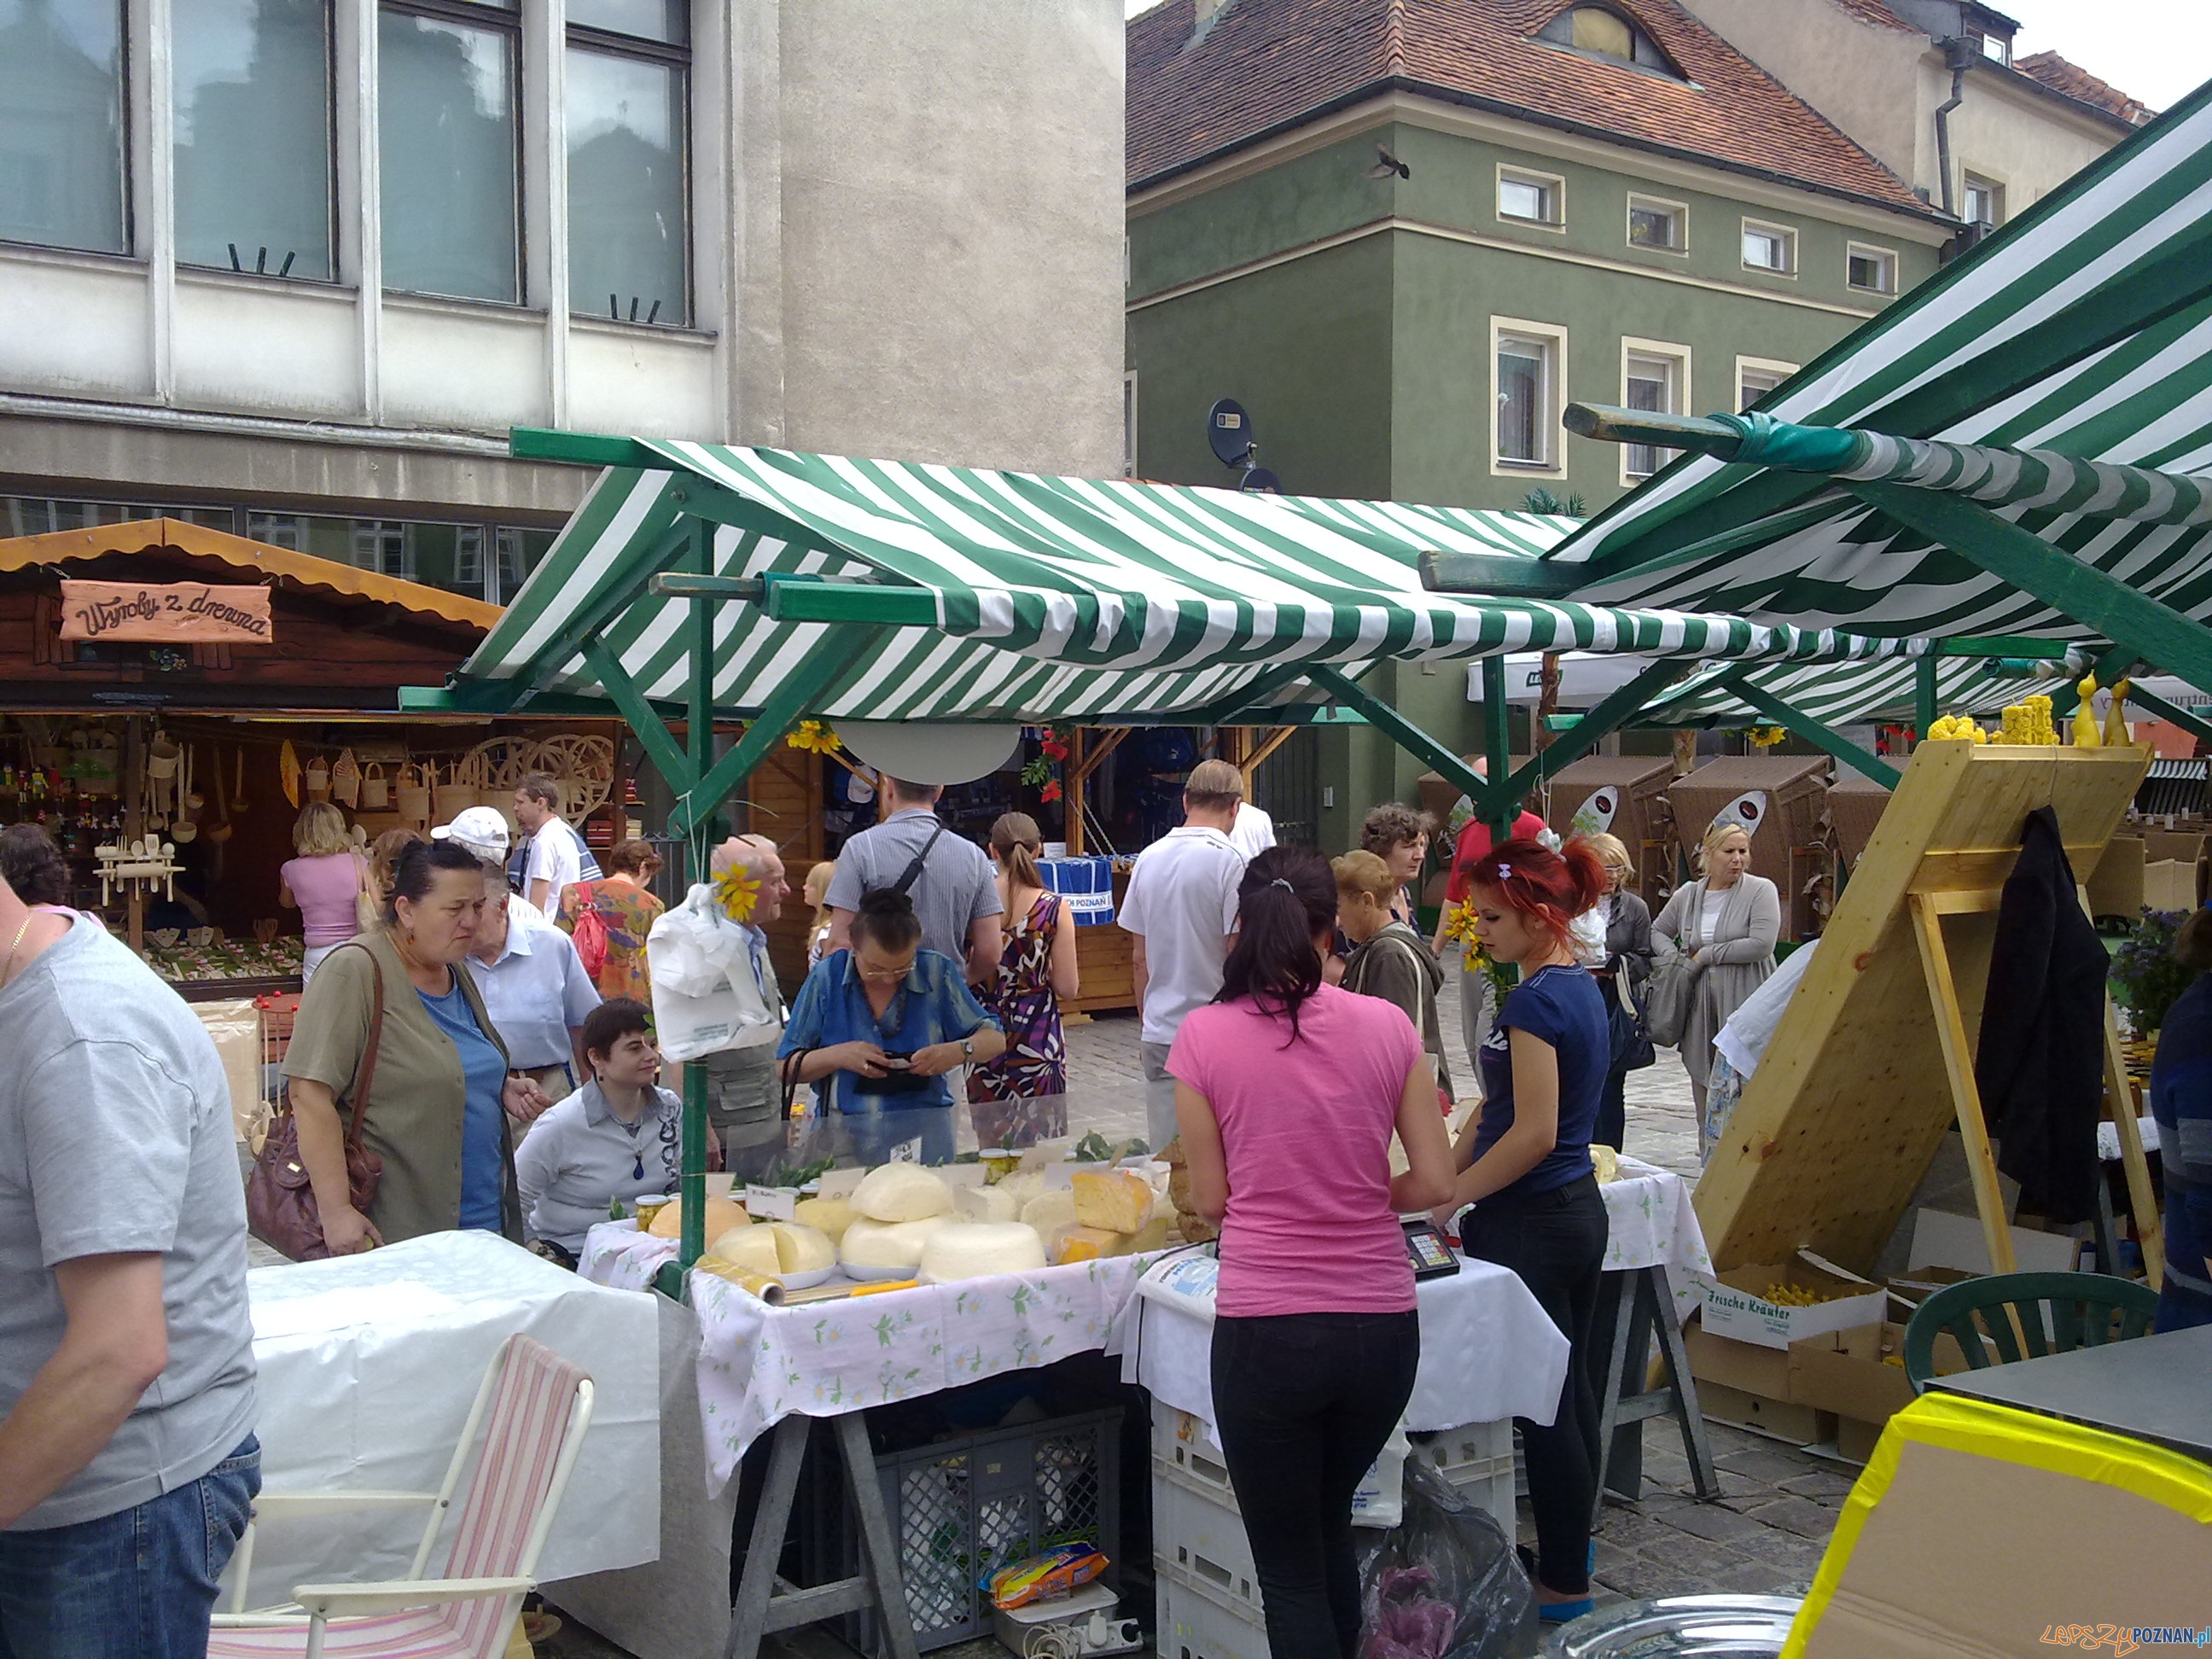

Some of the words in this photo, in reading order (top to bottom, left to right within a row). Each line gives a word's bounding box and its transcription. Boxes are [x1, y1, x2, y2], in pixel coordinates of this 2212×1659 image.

[75, 591, 160, 636] Wyroby
[164, 594, 183, 612] z
[186, 587, 267, 636] drewna
[1708, 1289, 1745, 1311] Frische
[1748, 1299, 1790, 1320] Kräuter
